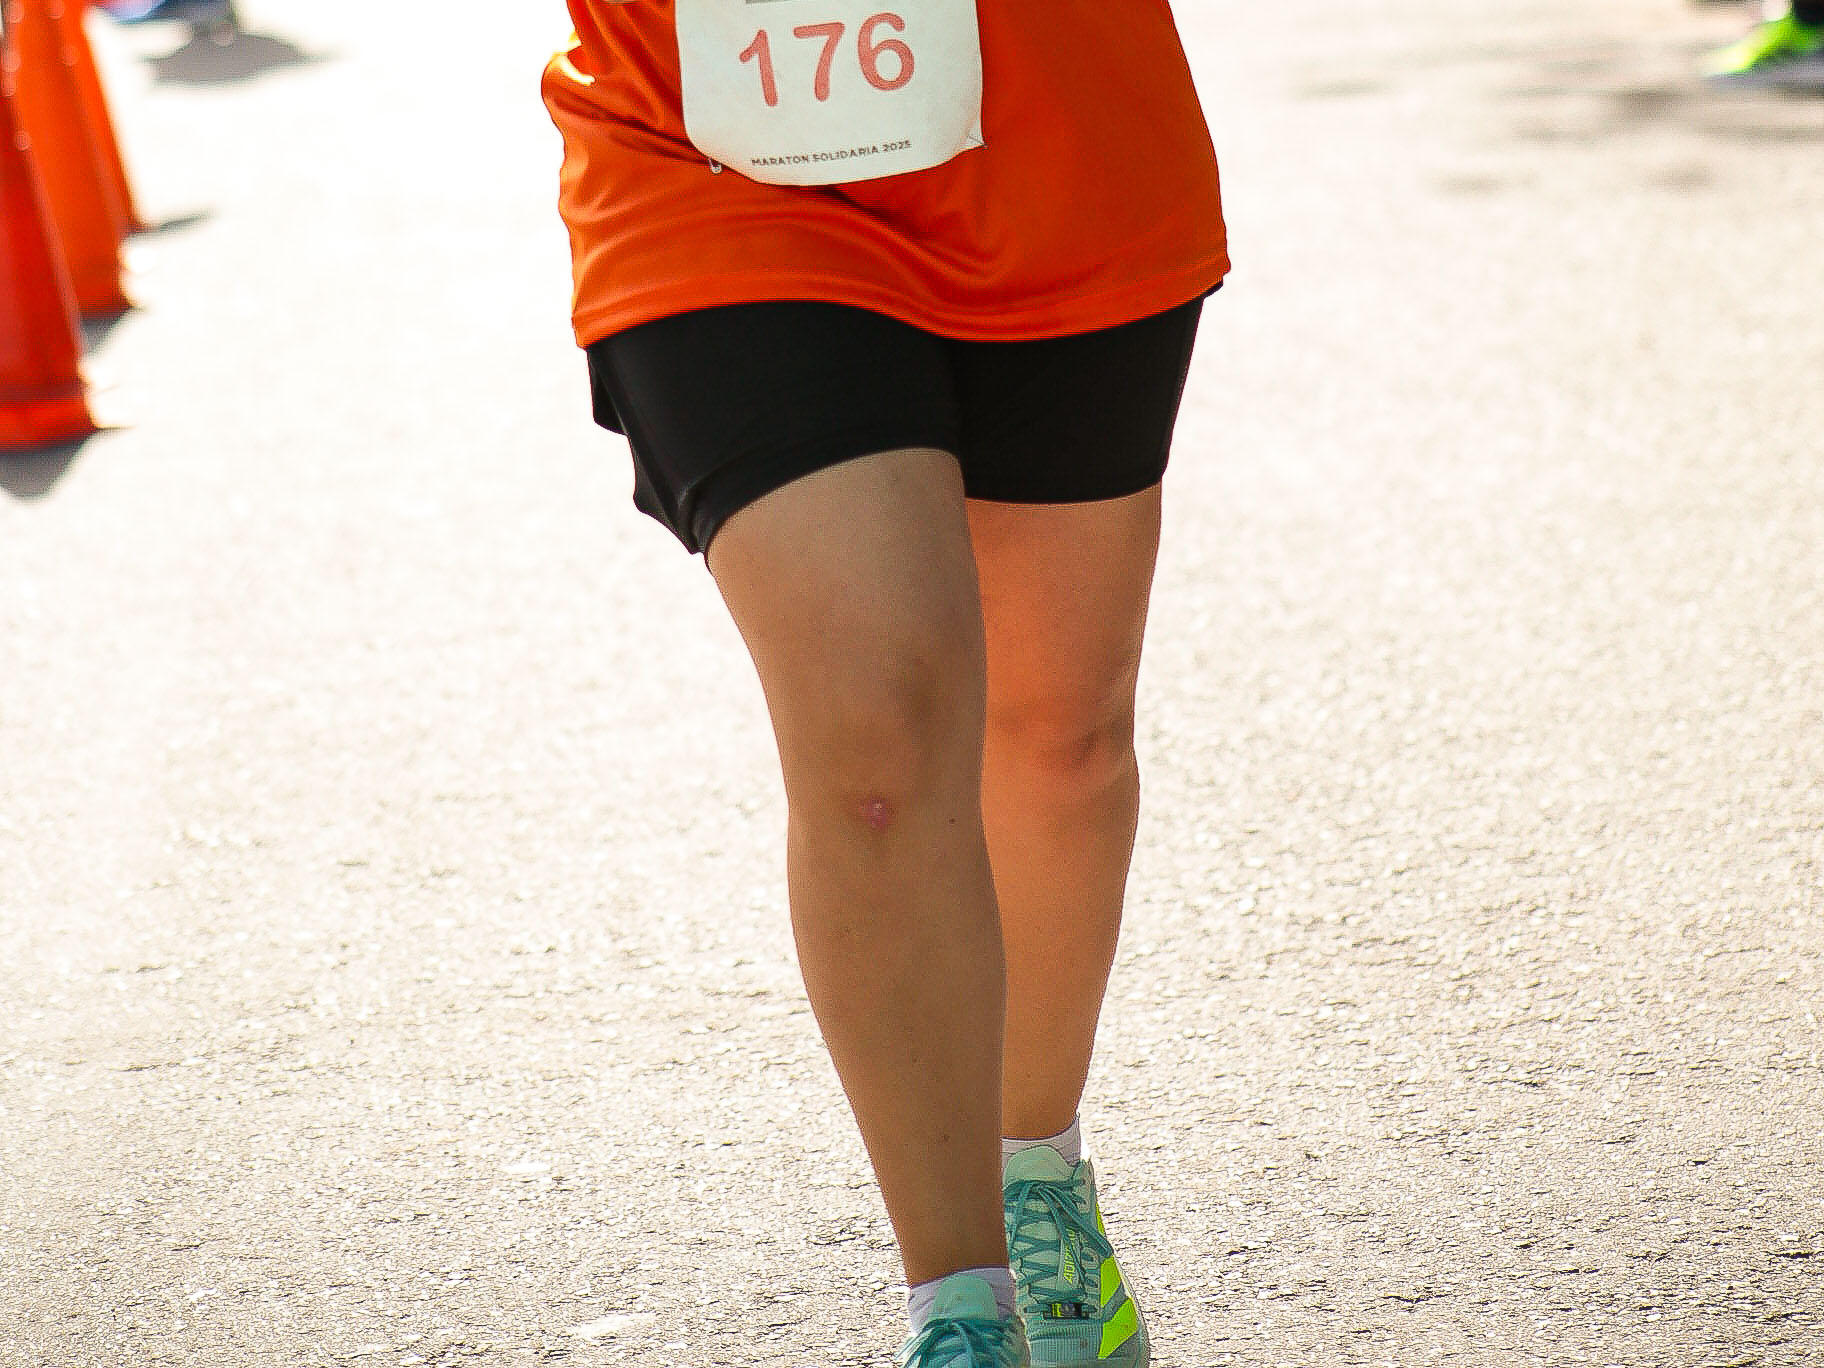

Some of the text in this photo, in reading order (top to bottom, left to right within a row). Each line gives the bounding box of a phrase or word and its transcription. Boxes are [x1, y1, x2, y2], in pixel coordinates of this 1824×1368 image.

[738, 12, 915, 107] 176
[751, 139, 912, 167] MARATON SOLIDARIA 2025
